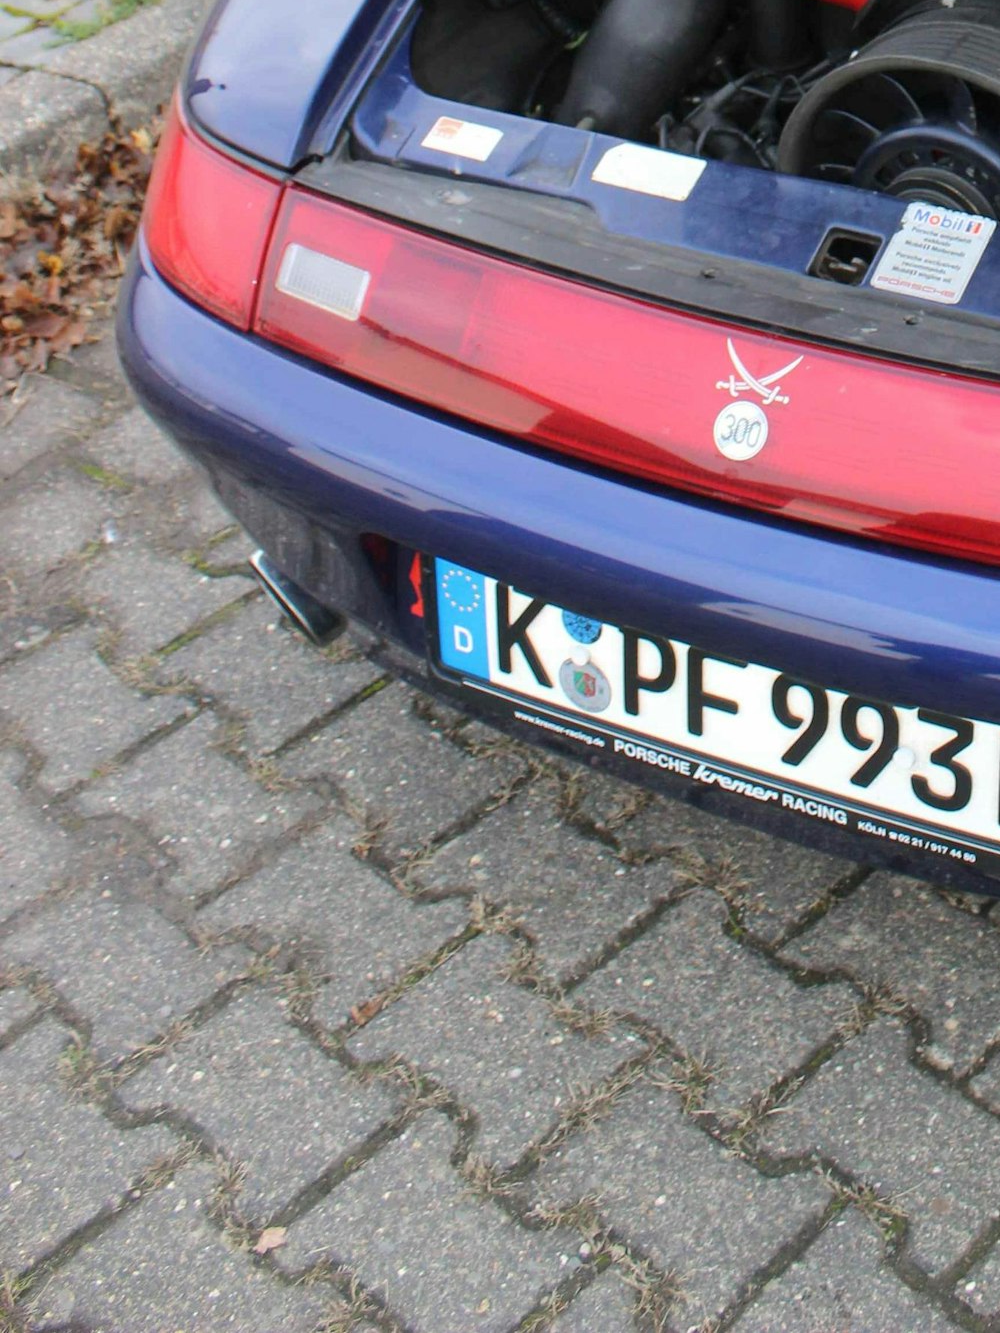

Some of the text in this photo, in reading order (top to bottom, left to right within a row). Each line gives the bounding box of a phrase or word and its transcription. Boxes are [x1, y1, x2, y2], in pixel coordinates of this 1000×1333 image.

[913, 209, 964, 231] Mobil
[720, 414, 762, 448] 300
[453, 625, 474, 654] D
[496, 581, 554, 688] K
[620, 627, 749, 736] PF
[613, 739, 848, 825] PORSCHE kremer RACING
[857, 820, 887, 837] KÖLN
